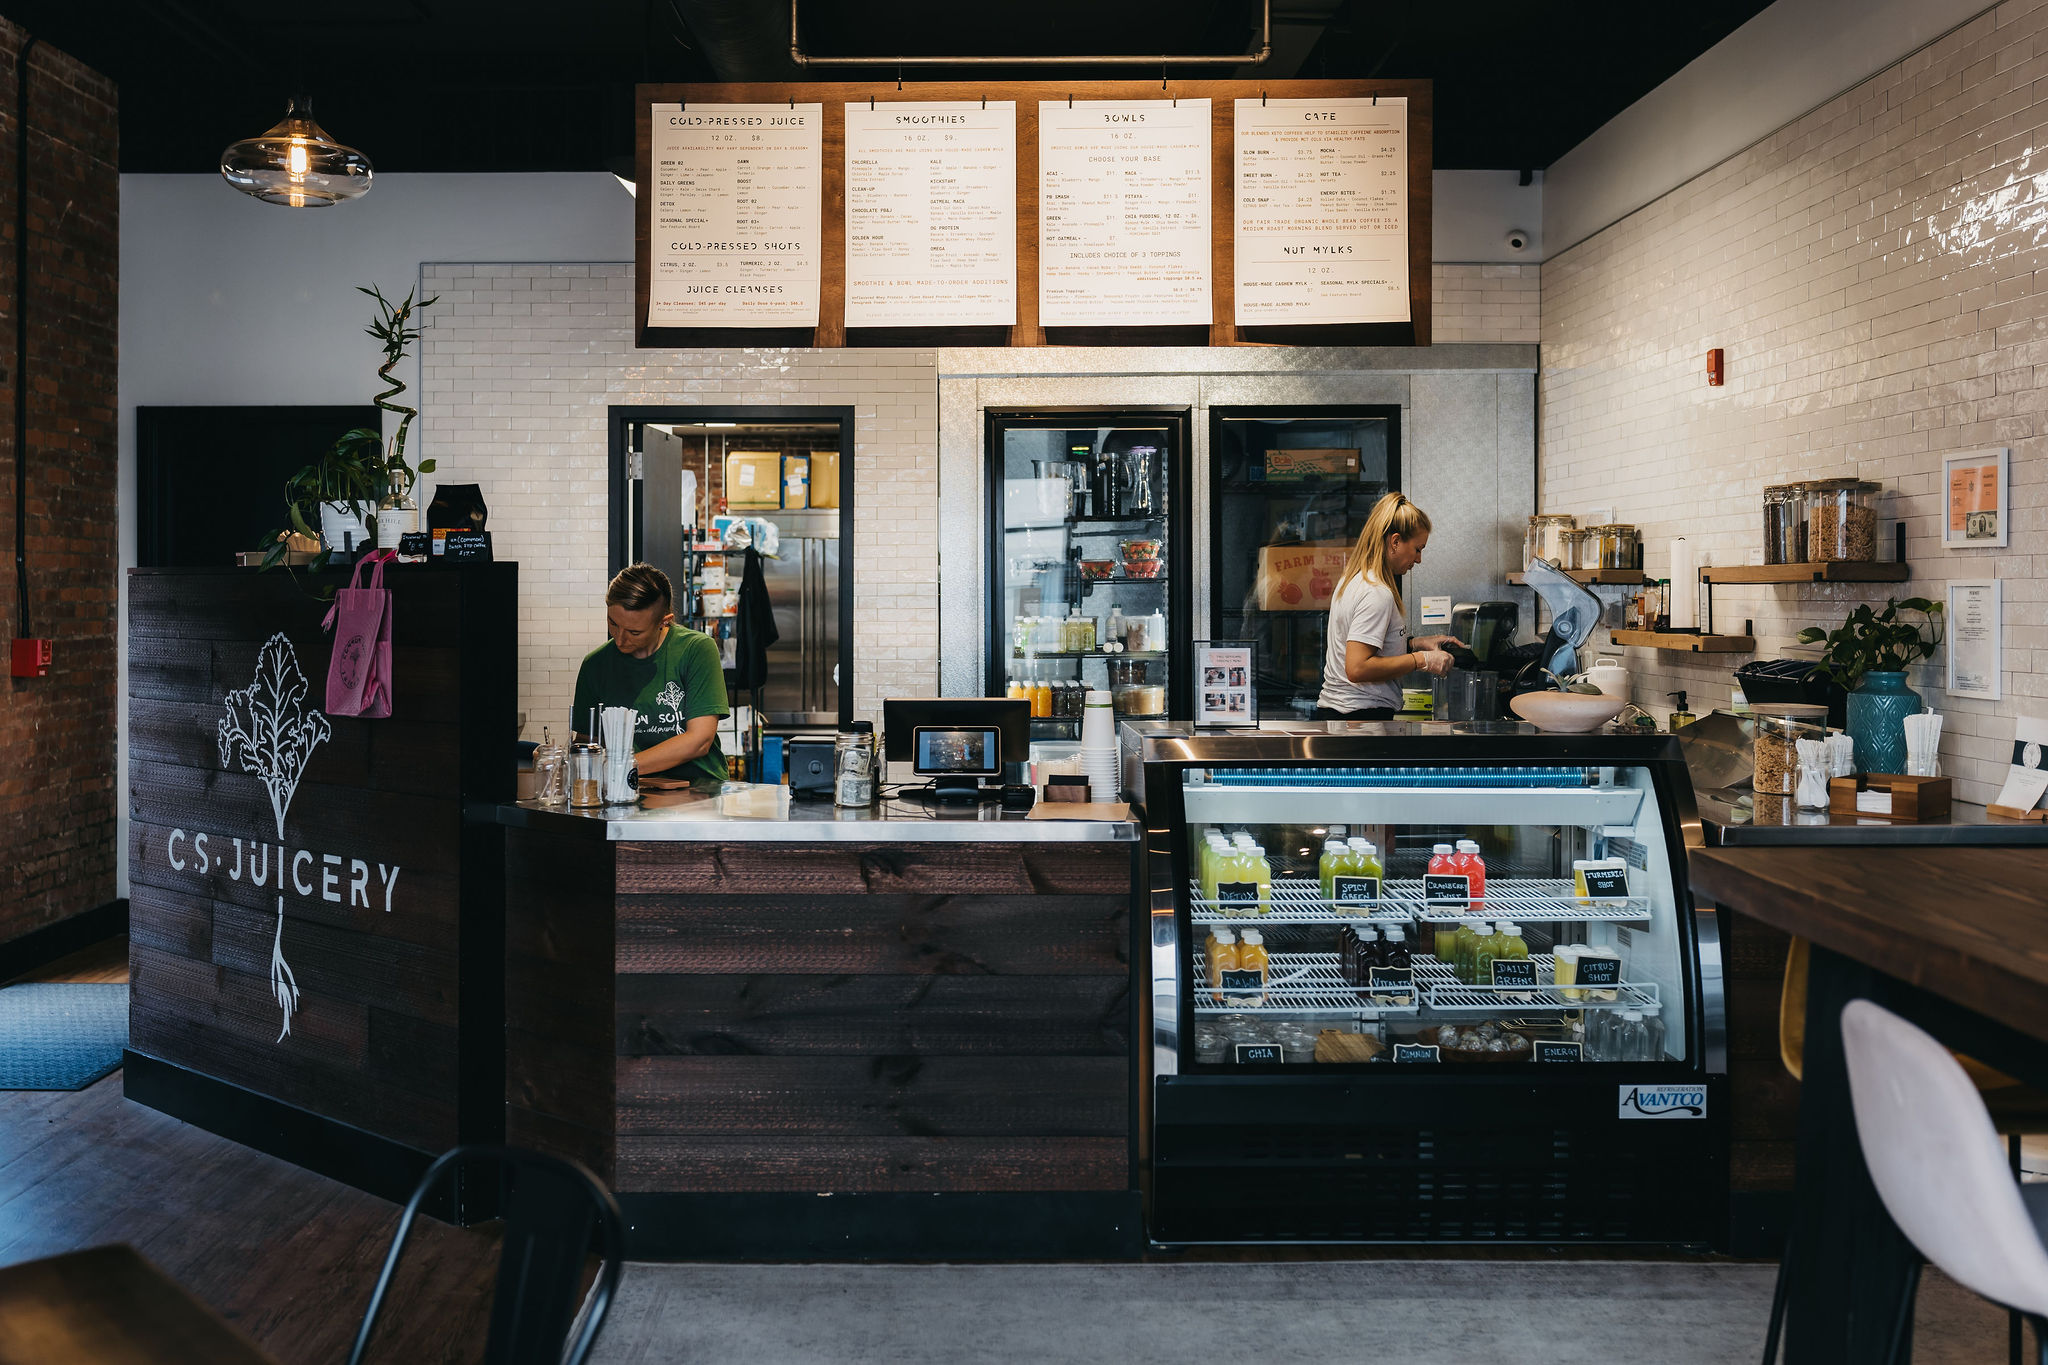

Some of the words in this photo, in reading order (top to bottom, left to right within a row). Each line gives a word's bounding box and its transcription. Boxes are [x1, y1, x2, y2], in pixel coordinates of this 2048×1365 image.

[1274, 456, 1292, 464] Dole
[1275, 555, 1315, 572] FARM
[658, 711, 685, 723] SOIL
[1585, 870, 1623, 879] TURMERIC
[1342, 883, 1367, 893] SPICY
[1427, 881, 1468, 891] CRANBERRY
[1597, 880, 1614, 889] SHOT
[1220, 891, 1255, 901] DETOX
[1341, 892, 1370, 900] GREEN
[1497, 964, 1530, 973] DAILY
[1583, 962, 1615, 973] CITRUS
[1225, 977, 1260, 988] DAWN
[1372, 977, 1412, 987] VITALITY
[1496, 975, 1533, 985] GREENS
[1588, 974, 1612, 982] SHOT
[1248, 1048, 1273, 1058] CHIA
[1544, 1048, 1577, 1056] ENERGY
[1622, 1087, 1704, 1109] AVANTCO
